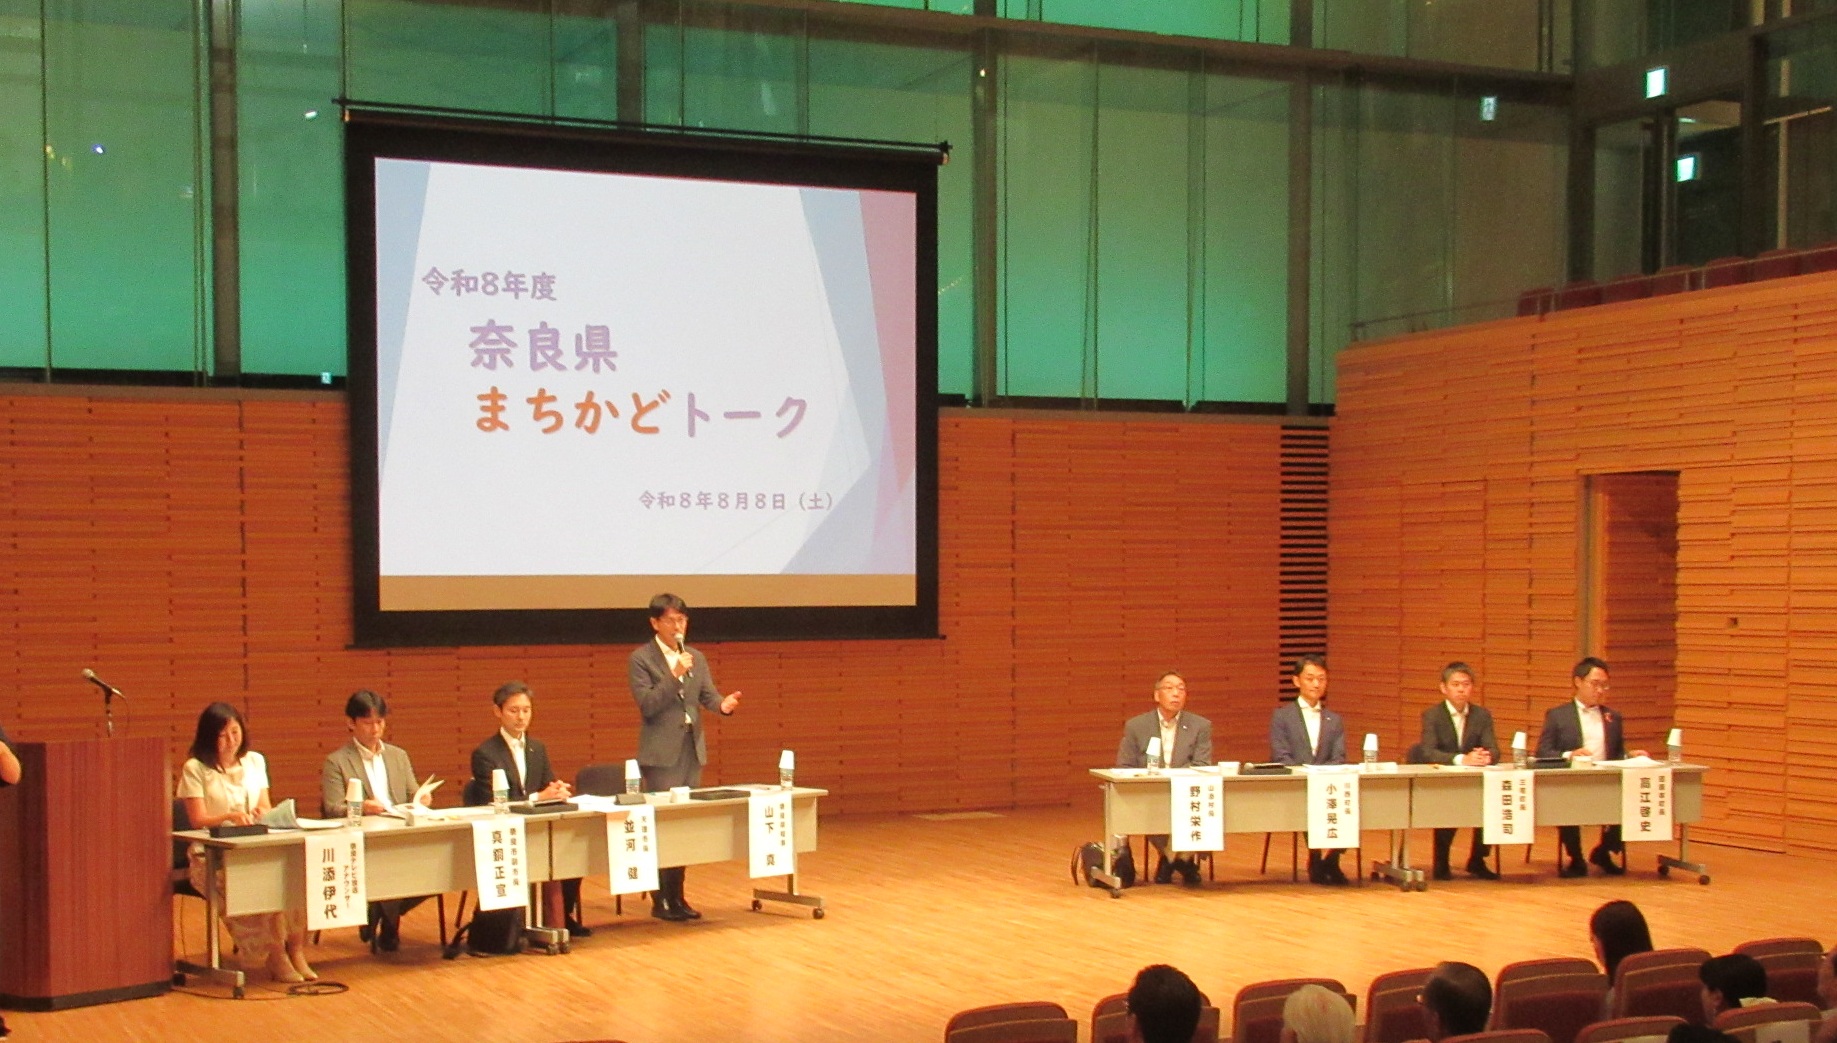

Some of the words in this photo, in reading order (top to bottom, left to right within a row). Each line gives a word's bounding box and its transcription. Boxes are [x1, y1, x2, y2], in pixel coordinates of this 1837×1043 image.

[421, 266, 557, 301] 令和8年度
[468, 319, 618, 374] 奈良県
[475, 386, 808, 439] まちかどトーク
[322, 847, 338, 920] 川添伊代
